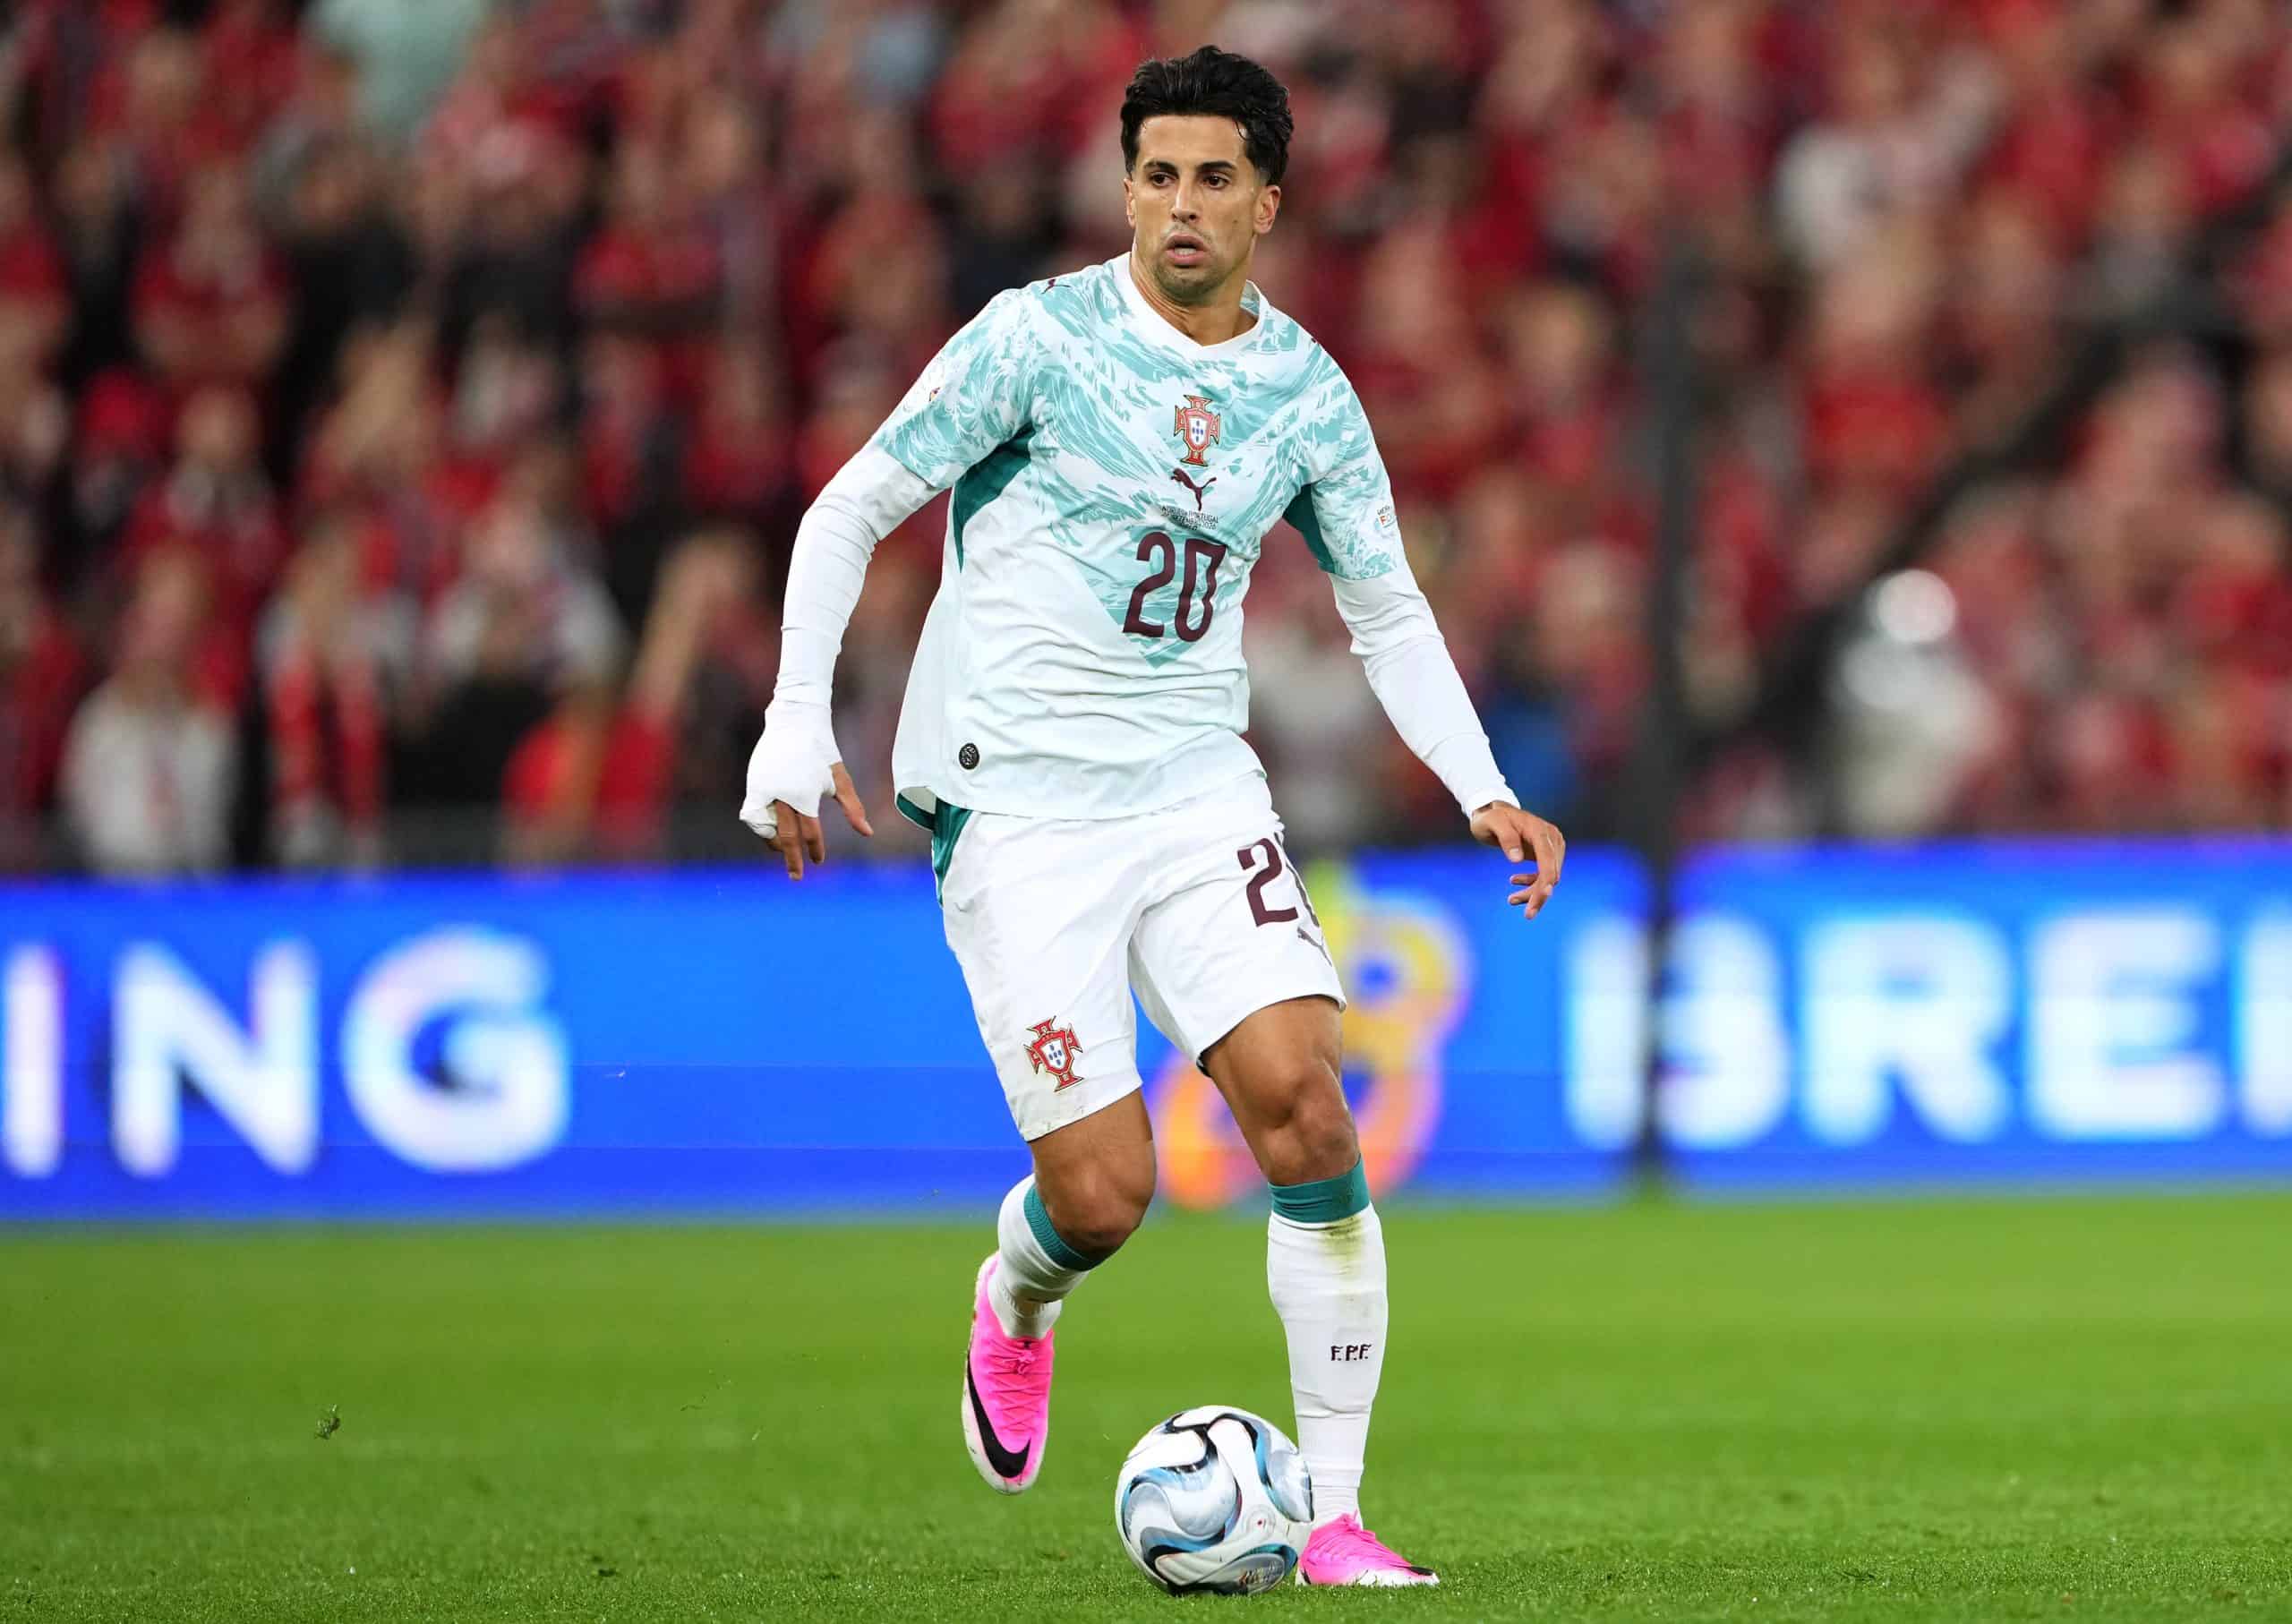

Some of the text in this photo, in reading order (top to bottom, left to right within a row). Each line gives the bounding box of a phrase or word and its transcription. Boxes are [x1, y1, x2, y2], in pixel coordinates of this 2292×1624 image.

[1123, 531, 1227, 642] 20
[4, 924, 571, 1178] ING
[1330, 1344, 1372, 1361] F.P.F.
